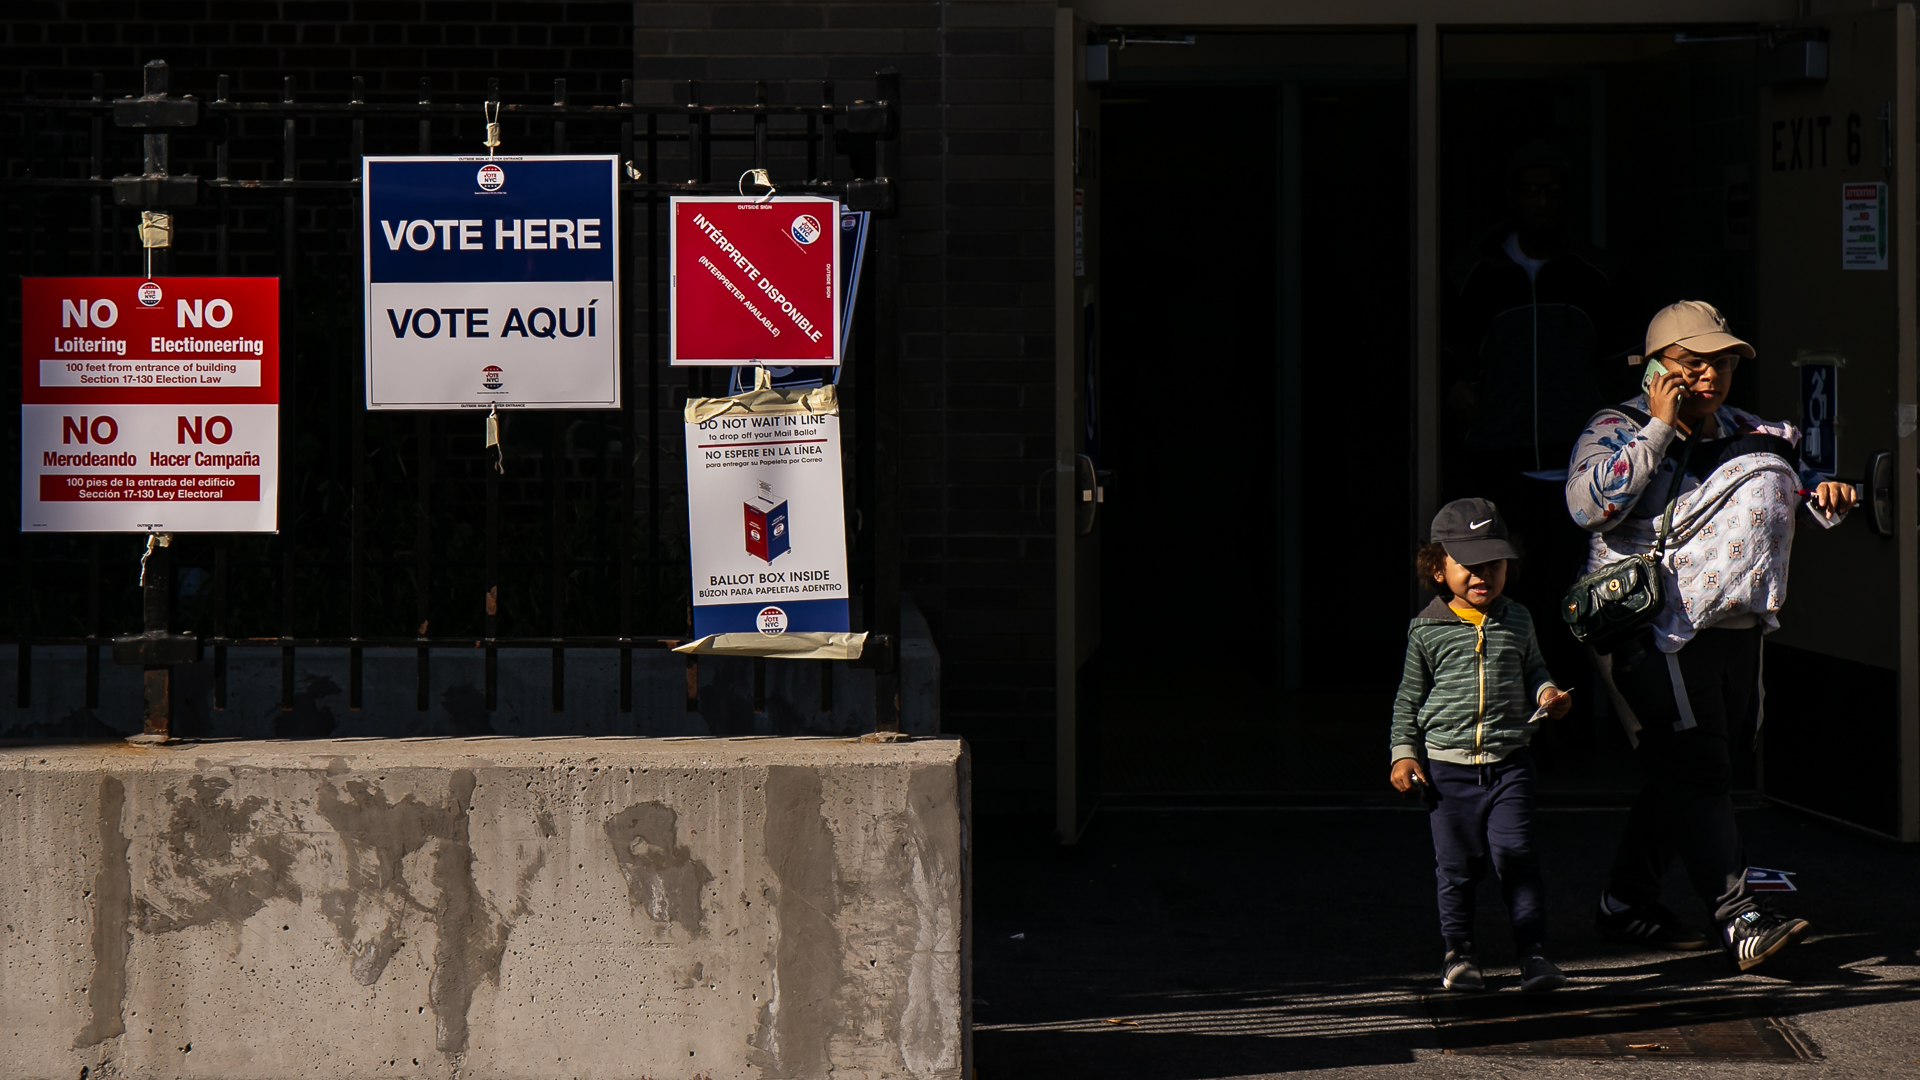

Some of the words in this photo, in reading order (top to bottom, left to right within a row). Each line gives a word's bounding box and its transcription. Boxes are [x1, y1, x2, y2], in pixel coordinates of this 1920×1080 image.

[1772, 115, 1831, 171] EXIT
[1847, 112, 1861, 166] 6
[381, 219, 483, 250] VOTE
[495, 218, 601, 250] HERE
[798, 225, 810, 237] NYC
[693, 213, 761, 281] INTÉRPRETE
[757, 277, 823, 343] DISPONIBLE
[698, 255, 746, 302] (INTERPRETER
[743, 300, 781, 338] AVAILABLE)
[62, 299, 118, 329] NO
[177, 299, 233, 329] NO
[386, 308, 489, 339] VOTE
[500, 298, 599, 340] AQUÍ
[54, 337, 127, 356] Loitering
[151, 337, 264, 356] Electioneering
[65, 363, 83, 372] 100
[85, 363, 107, 372] feet
[108, 363, 132, 372] from
[134, 364, 180, 372] entrance
[182, 363, 194, 372] of
[196, 363, 236, 374] building
[80, 374, 119, 384] Section
[122, 374, 153, 384] 17-130
[156, 374, 197, 384] Election
[200, 374, 222, 384] Law
[62, 415, 119, 445] NO
[177, 415, 233, 445] NO
[700, 420, 718, 430] DO
[722, 418, 747, 429] NOT
[751, 416, 780, 428] WAIT
[784, 415, 797, 426] IN
[801, 414, 826, 425] LINE
[719, 432, 739, 441] drop
[741, 432, 752, 440] off
[754, 432, 772, 440] your
[774, 429, 792, 438] Mail
[794, 428, 817, 437] Ballot
[43, 451, 137, 466] Merodeando
[150, 451, 191, 466] Hacer
[195, 451, 260, 469] Campaña
[705, 451, 721, 460] NO
[725, 449, 760, 458] ESPERE
[762, 448, 775, 457] EN
[779, 447, 791, 456] LA
[794, 444, 822, 455] LÍNEA
[722, 460, 749, 468] entregar
[66, 478, 83, 486] 100
[86, 478, 108, 488] pies
[110, 478, 123, 486] de
[126, 478, 135, 486] la
[138, 478, 177, 486] entrada
[180, 478, 195, 486] del
[198, 478, 235, 486] edificio
[78, 489, 120, 499] Sección
[123, 490, 154, 499] 17-130
[156, 490, 175, 500] Ley
[178, 490, 223, 499] Electoral
[710, 574, 755, 586] BALLOT
[759, 572, 785, 584] BOX
[790, 570, 830, 582] INSIDE
[699, 588, 728, 598] BÚZON
[730, 587, 753, 596] PARA
[756, 586, 800, 595] PAPELETAS
[802, 584, 842, 592] ADENTRO
